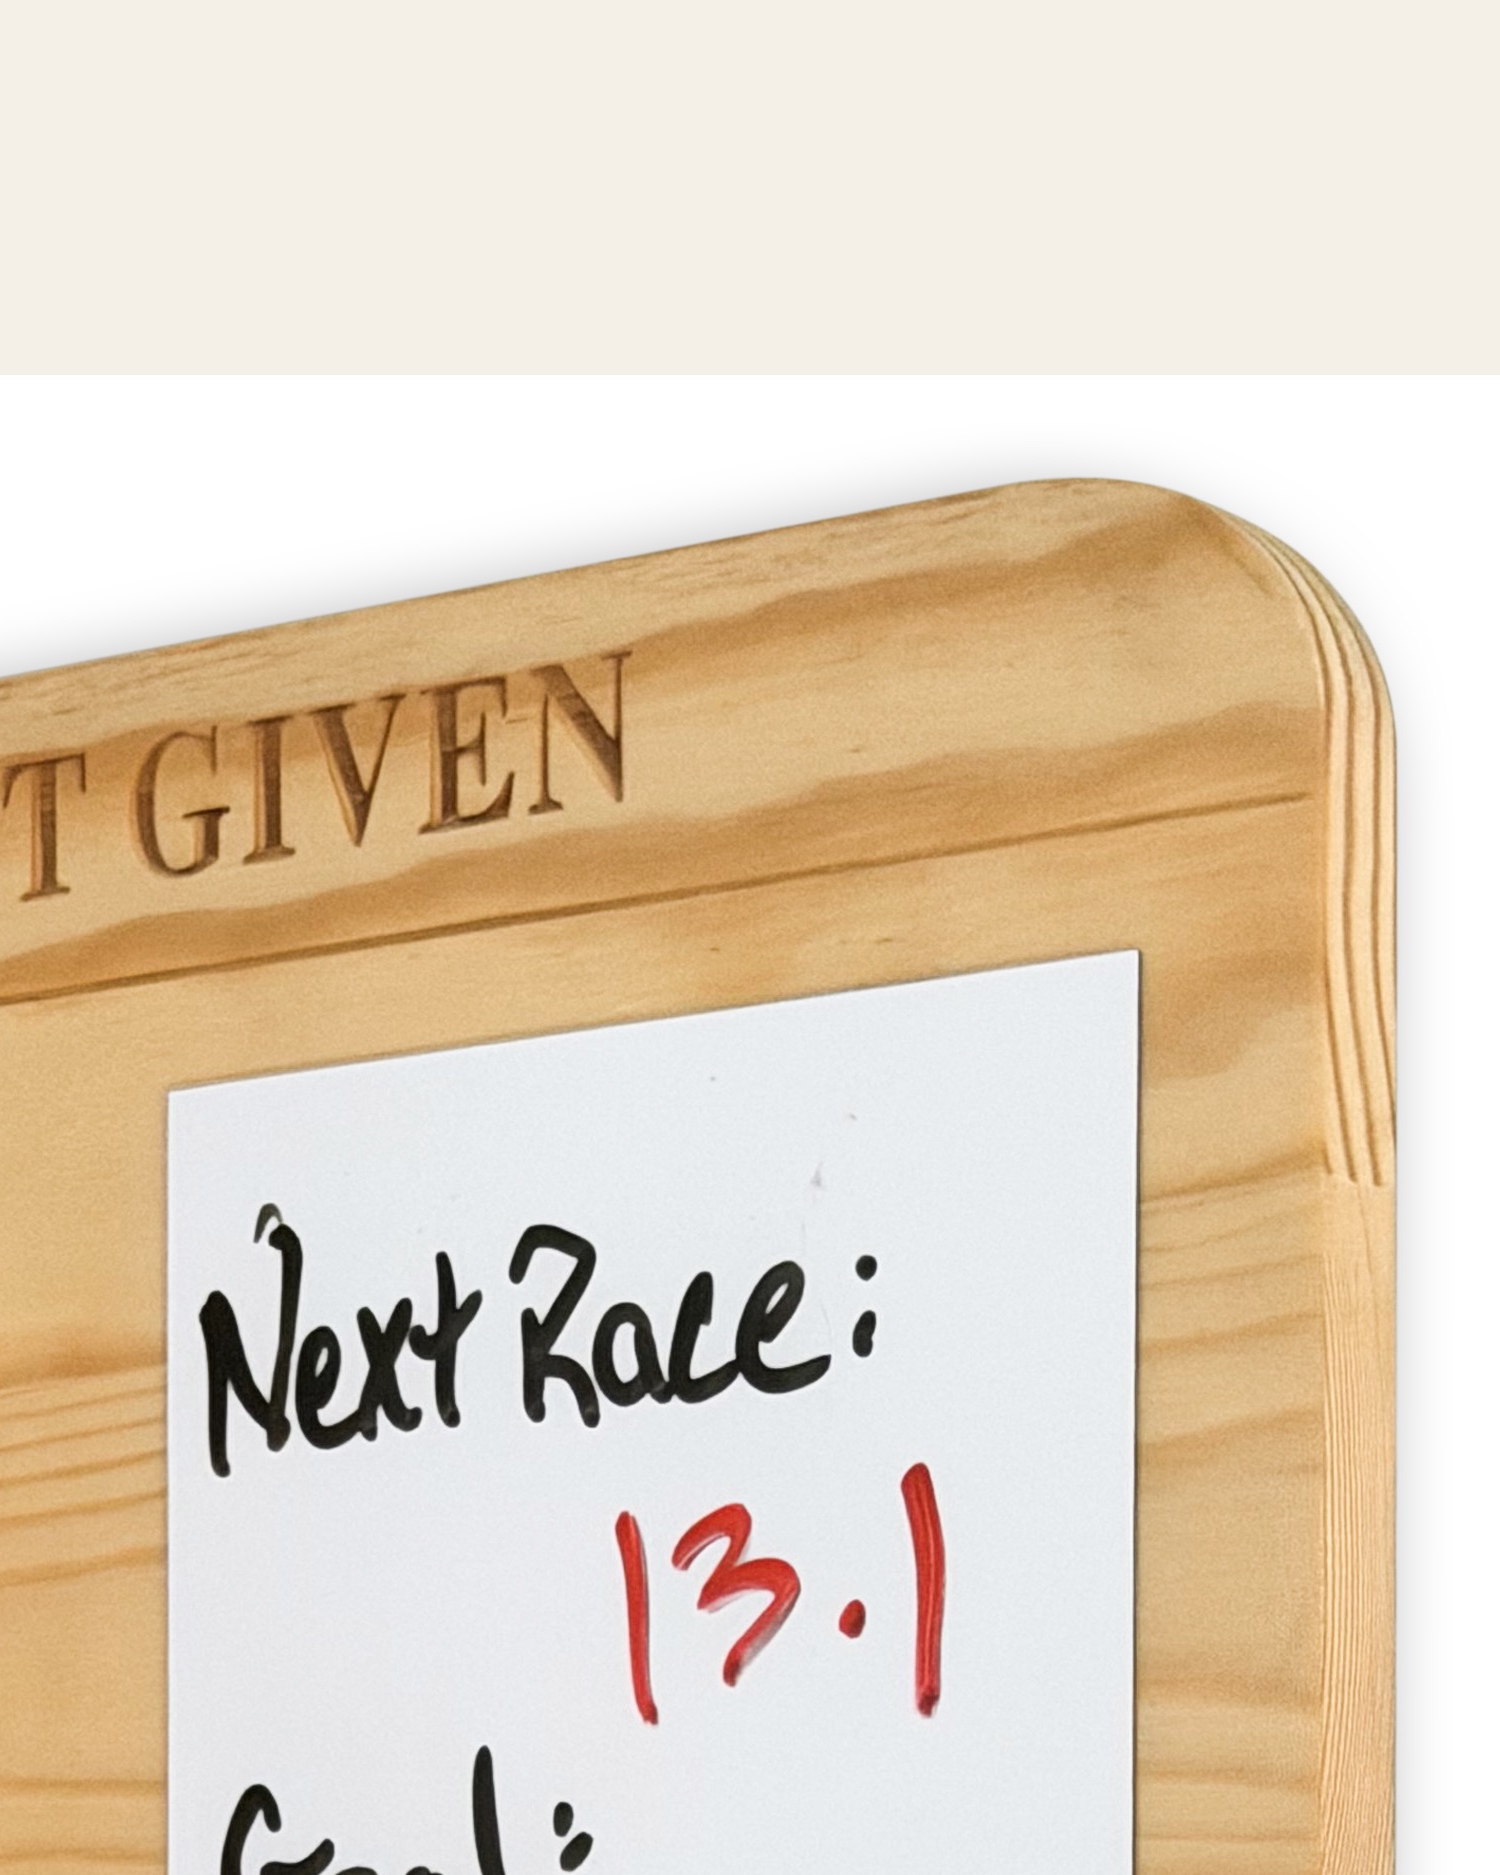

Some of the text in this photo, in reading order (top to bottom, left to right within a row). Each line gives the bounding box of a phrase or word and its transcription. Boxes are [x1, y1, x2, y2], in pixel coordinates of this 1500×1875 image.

[132, 651, 633, 882] GIVEN
[198, 1204, 878, 1478] Next Race:
[614, 1463, 945, 1724] 13.1
